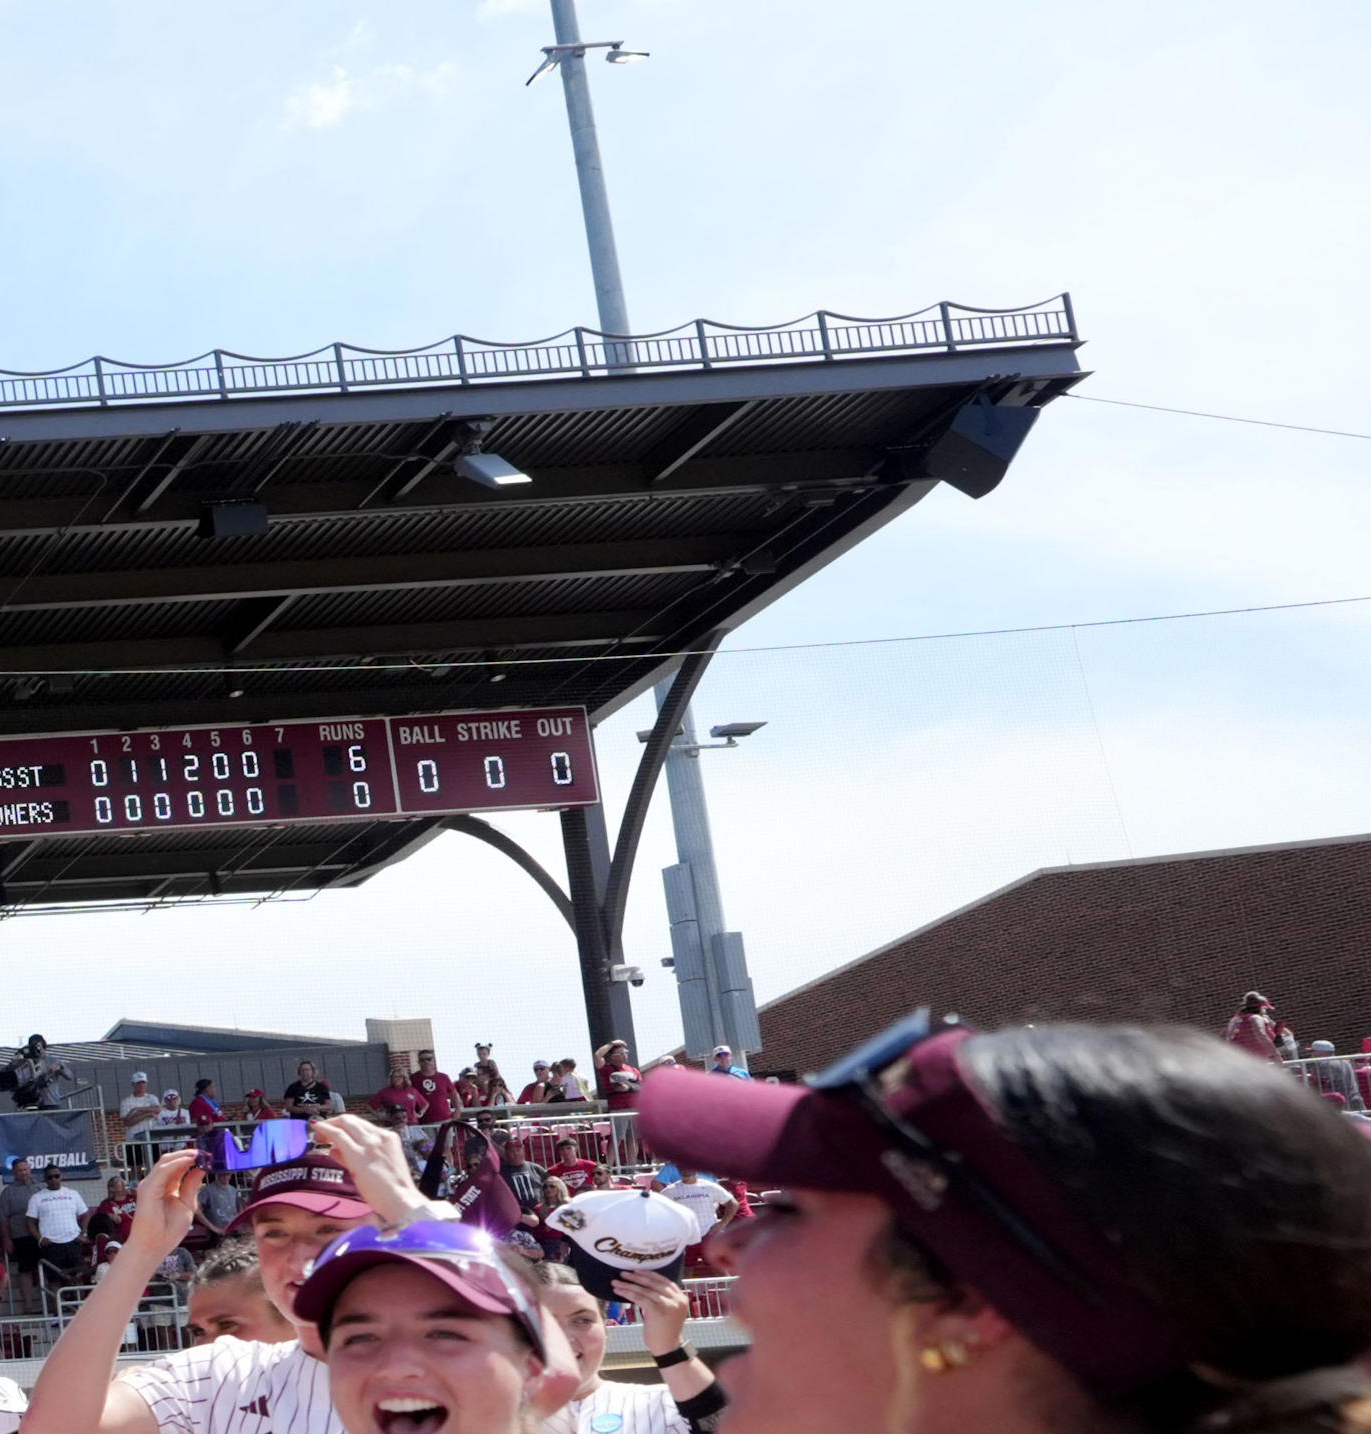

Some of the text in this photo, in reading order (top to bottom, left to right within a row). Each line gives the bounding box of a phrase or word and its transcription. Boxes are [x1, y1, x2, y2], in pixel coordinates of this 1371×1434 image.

[90, 723, 365, 753] 1 2 3 4 5 6 7 RUNS
[399, 717, 573, 744] BALL STRIKE OUT
[90, 760, 107, 786] 0
[130, 759, 137, 783] 1
[160, 758, 167, 781] 1
[184, 755, 199, 781] 2
[212, 753, 229, 779] 0
[242, 751, 259, 777] 0
[349, 745, 366, 772] 6
[417, 752, 572, 792] 0 0 0
[95, 797, 112, 823] 0
[125, 795, 142, 821] 0
[154, 793, 171, 819] 0
[187, 791, 204, 817] 0
[217, 789, 234, 815] 0
[247, 787, 264, 814] 0
[353, 781, 370, 808] 0
[25, 1151, 89, 1170] SOFTBALL
[258, 1166, 344, 1190] MISSISSIPPI STATE
[460, 1185, 482, 1206] STATE
